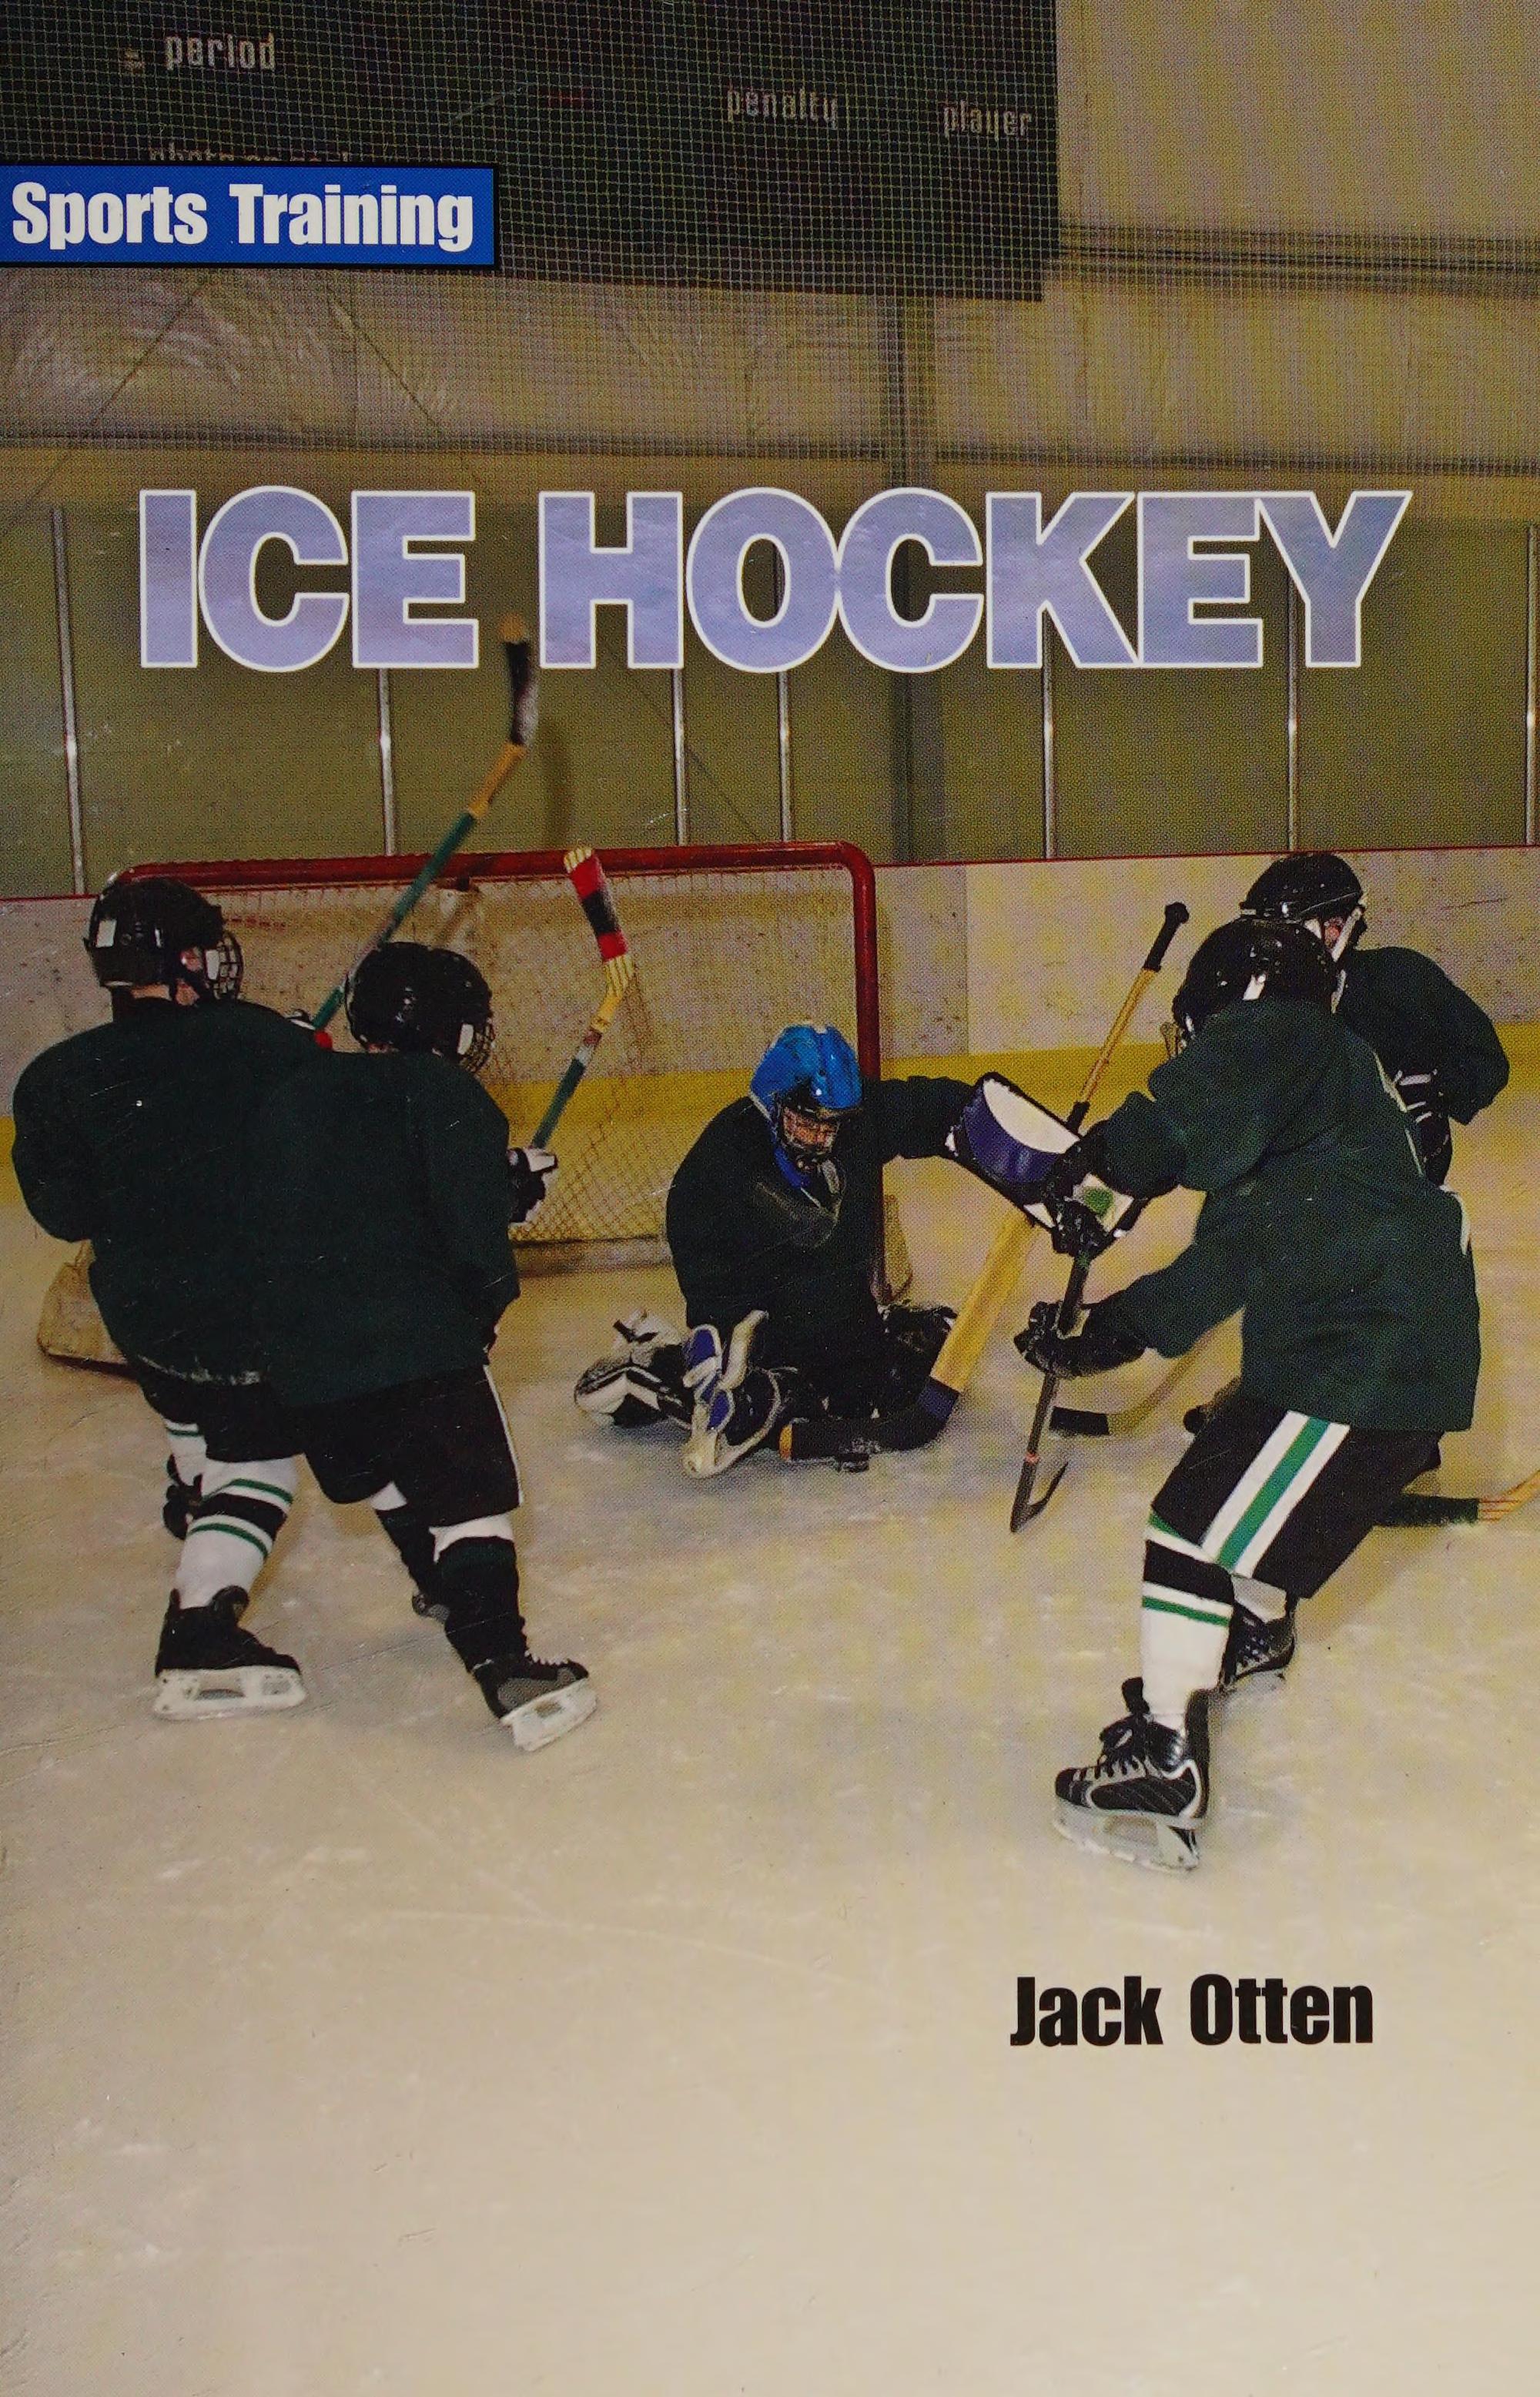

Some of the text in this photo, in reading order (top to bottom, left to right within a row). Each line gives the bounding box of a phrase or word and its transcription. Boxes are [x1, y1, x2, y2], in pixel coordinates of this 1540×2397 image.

[165, 32, 276, 71] period
[727, 87, 839, 129] penalty
[942, 99, 1033, 142] player
[12, 181, 474, 253] Sports Training
[139, 485, 1414, 675] ICE HOCKEY
[1009, 1973, 1374, 2047] Jack Otten
